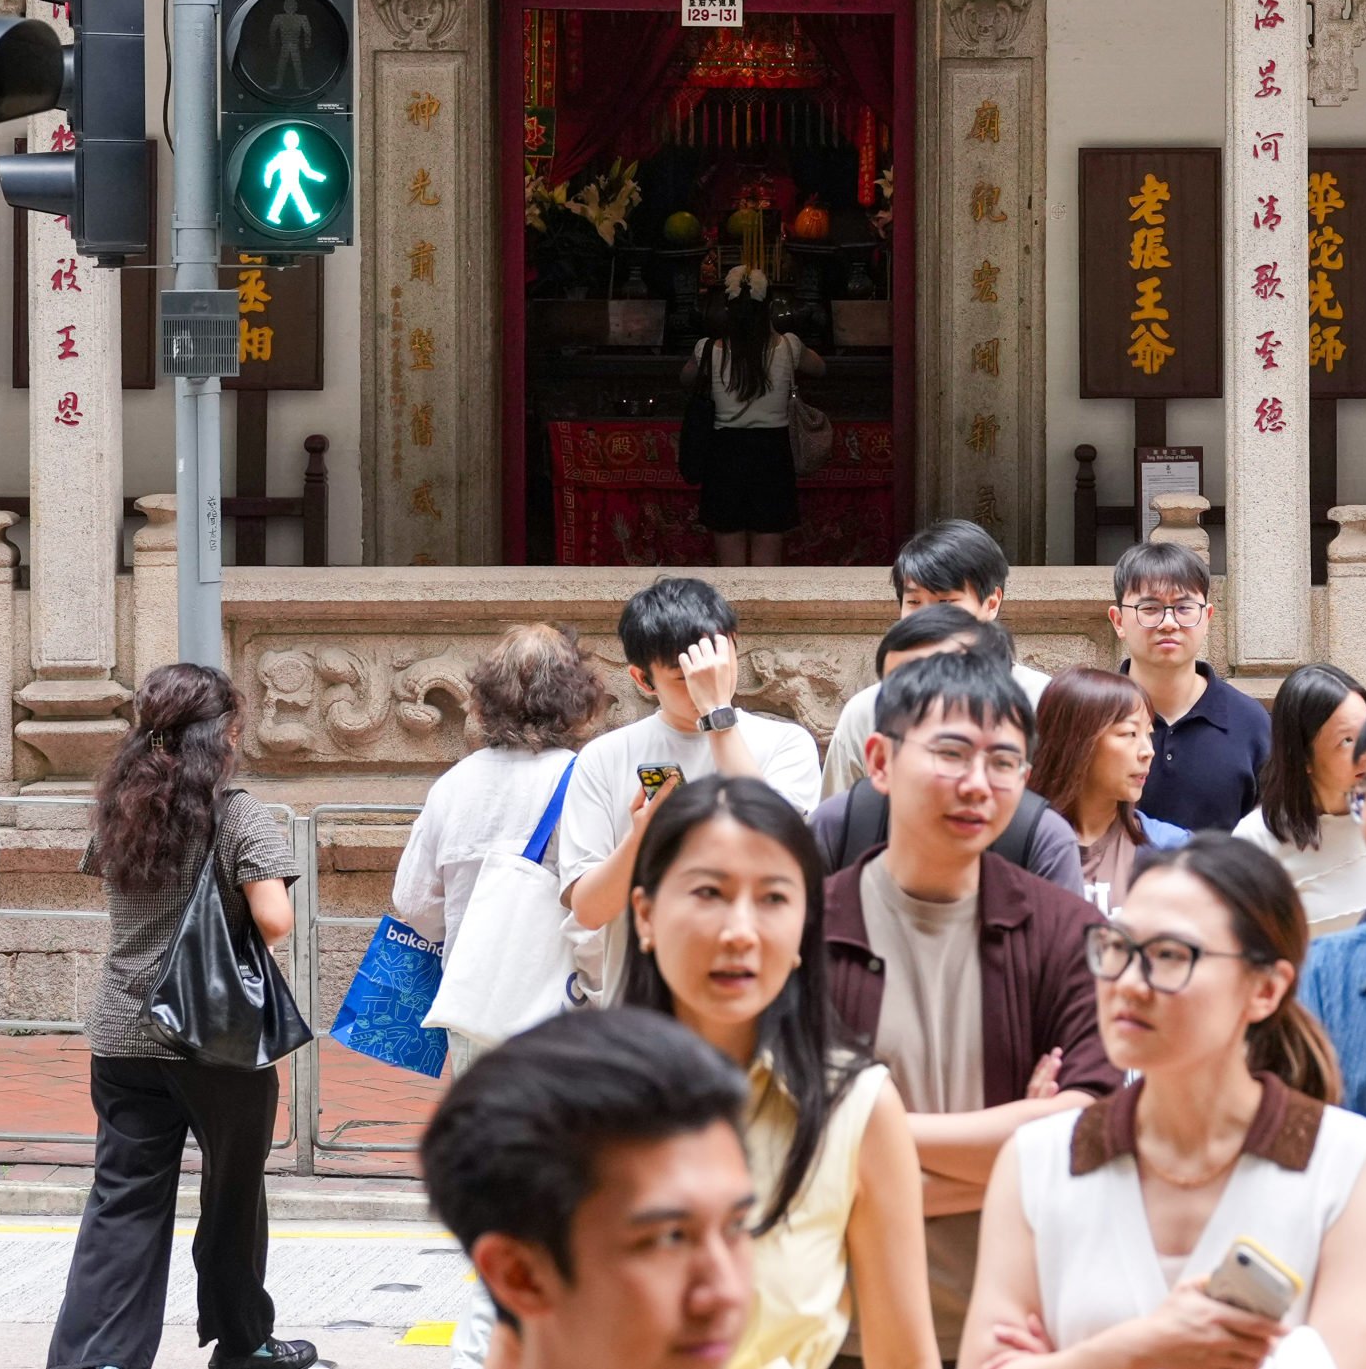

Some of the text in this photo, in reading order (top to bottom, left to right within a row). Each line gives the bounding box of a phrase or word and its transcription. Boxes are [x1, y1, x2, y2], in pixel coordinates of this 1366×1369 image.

[687, 8, 737, 22] 129-131
[1126, 173, 1176, 375] 老張王爺
[238, 252, 275, 364] 丞相
[611, 434, 891, 456] 洪 殿
